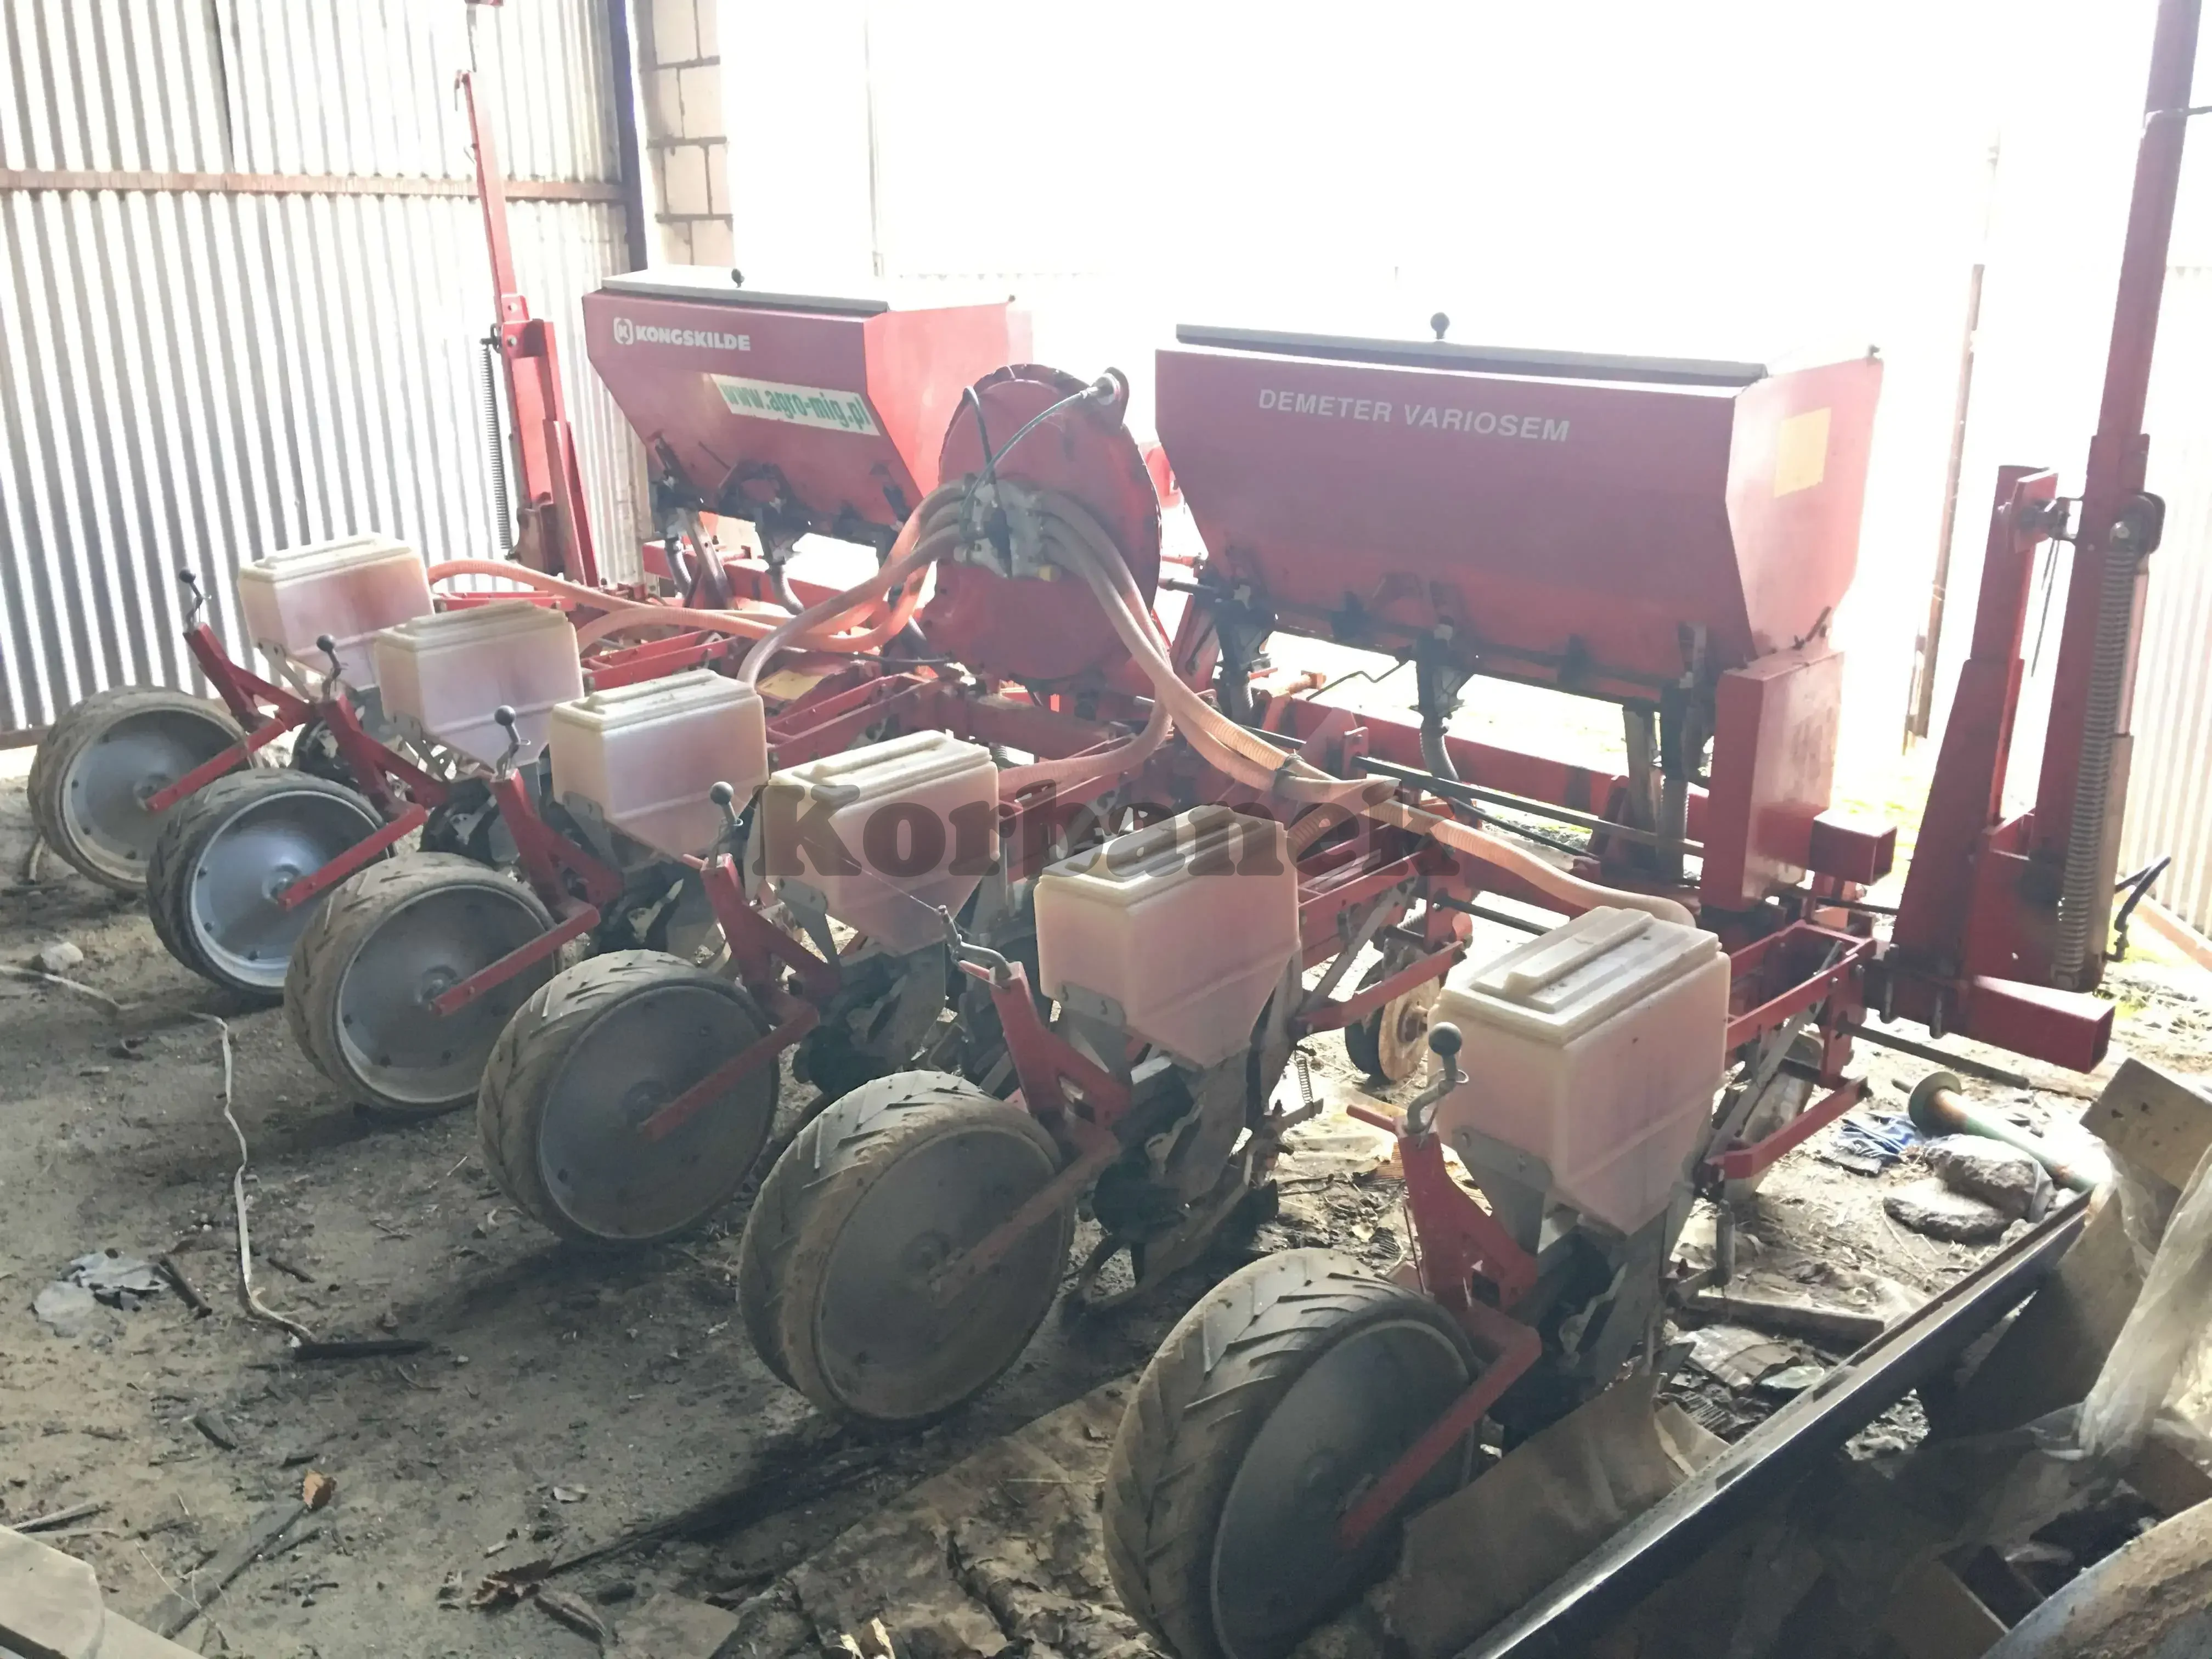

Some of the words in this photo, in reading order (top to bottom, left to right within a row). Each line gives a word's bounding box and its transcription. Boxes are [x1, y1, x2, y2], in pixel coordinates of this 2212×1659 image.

[635, 325, 751, 351] KONGSKILDE
[719, 384, 871, 431] www.agro-mig.pl
[1259, 388, 1393, 422] DEMETER
[1404, 404, 1570, 442] VARIOSEM
